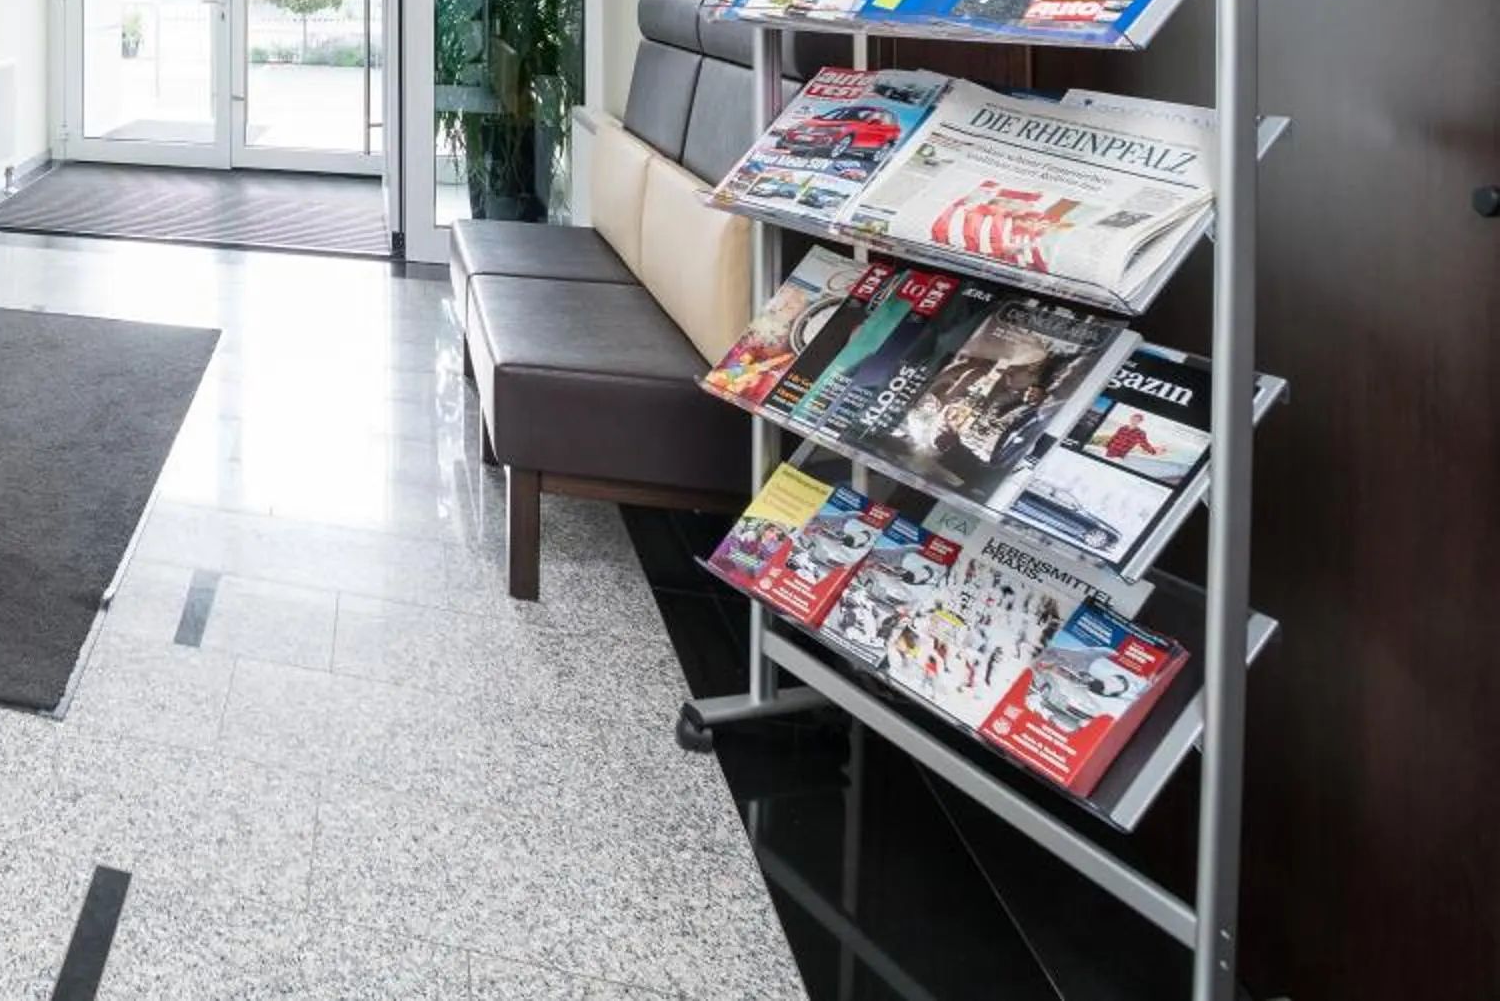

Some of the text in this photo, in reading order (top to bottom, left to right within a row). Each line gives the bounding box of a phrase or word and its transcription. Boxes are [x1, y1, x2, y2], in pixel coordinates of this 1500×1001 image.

[969, 107, 1022, 135] DIE
[1017, 116, 1198, 175] RHEINPFALZ
[1107, 369, 1194, 407] gazin
[986, 536, 1116, 608] LEBENSMITTEL
